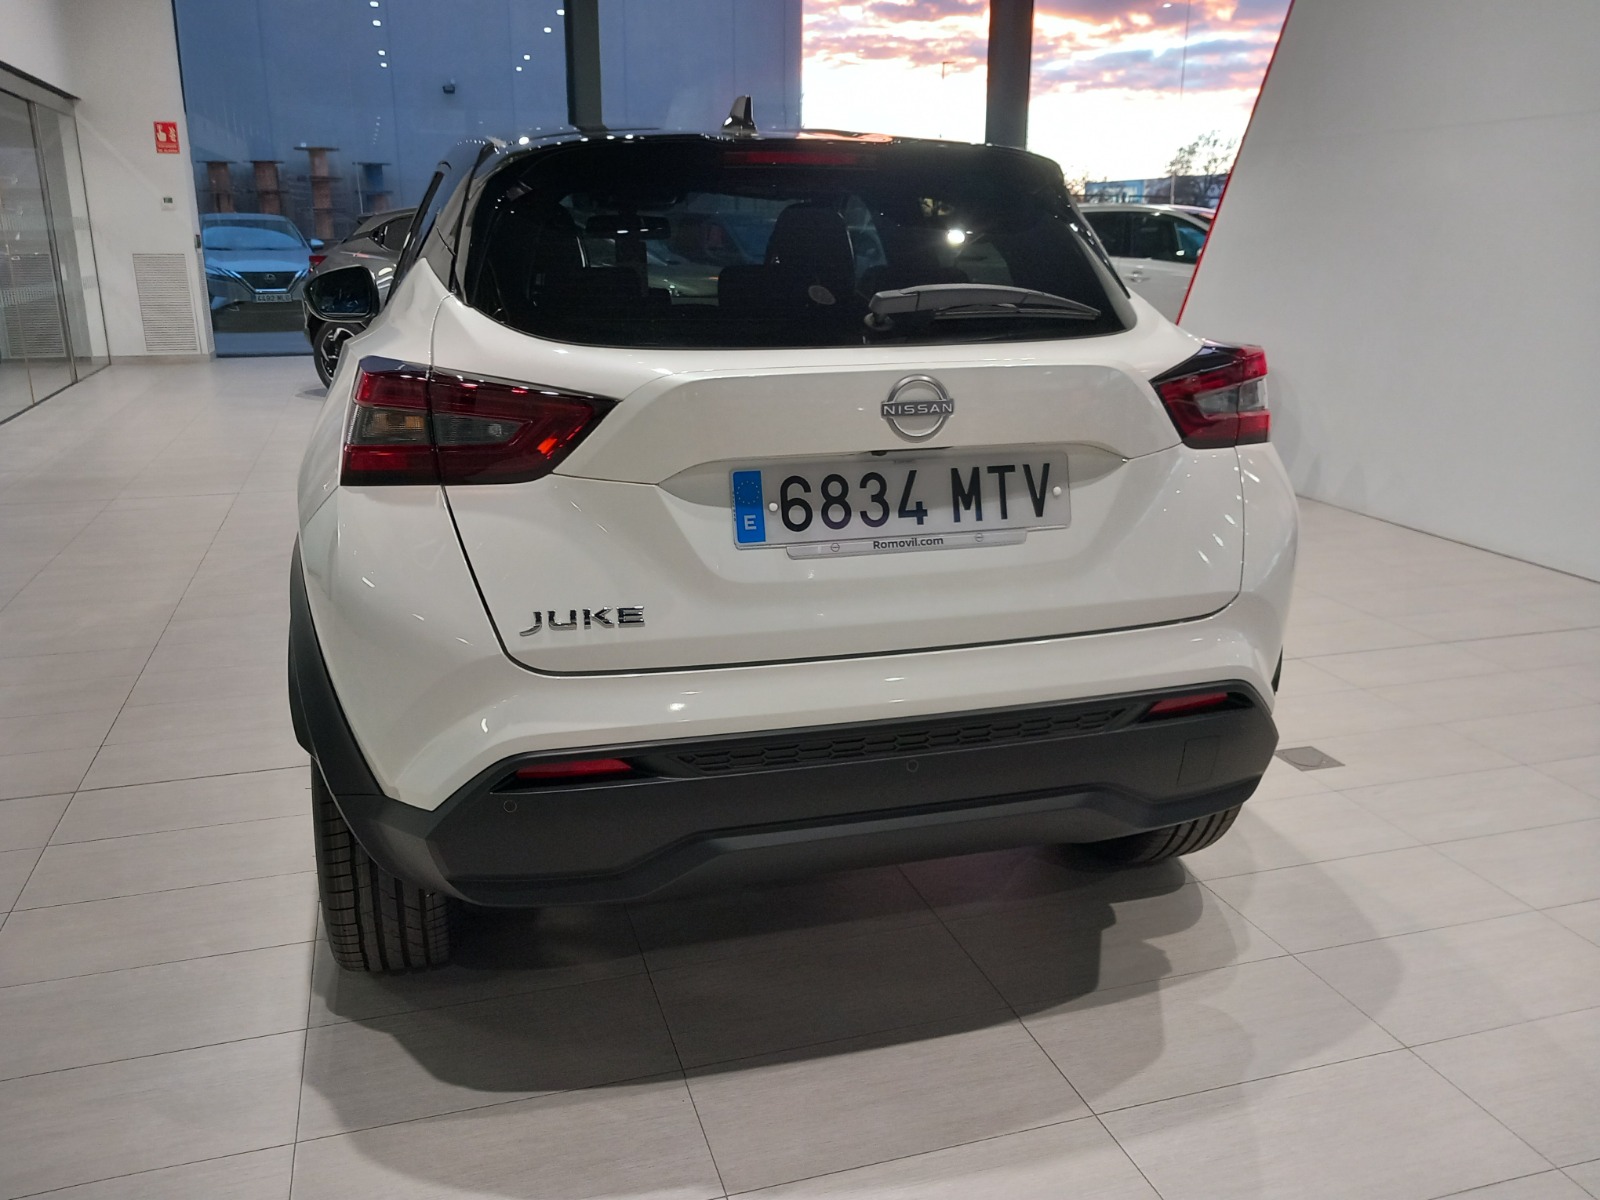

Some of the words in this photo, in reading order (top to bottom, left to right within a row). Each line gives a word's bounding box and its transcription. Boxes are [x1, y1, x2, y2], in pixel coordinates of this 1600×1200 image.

[883, 403, 952, 415] NISSAN
[780, 470, 928, 532] 6834
[951, 463, 1050, 523] MTV
[744, 514, 757, 531] E
[873, 537, 944, 550] Romovil.com
[519, 606, 645, 637] JUKE
